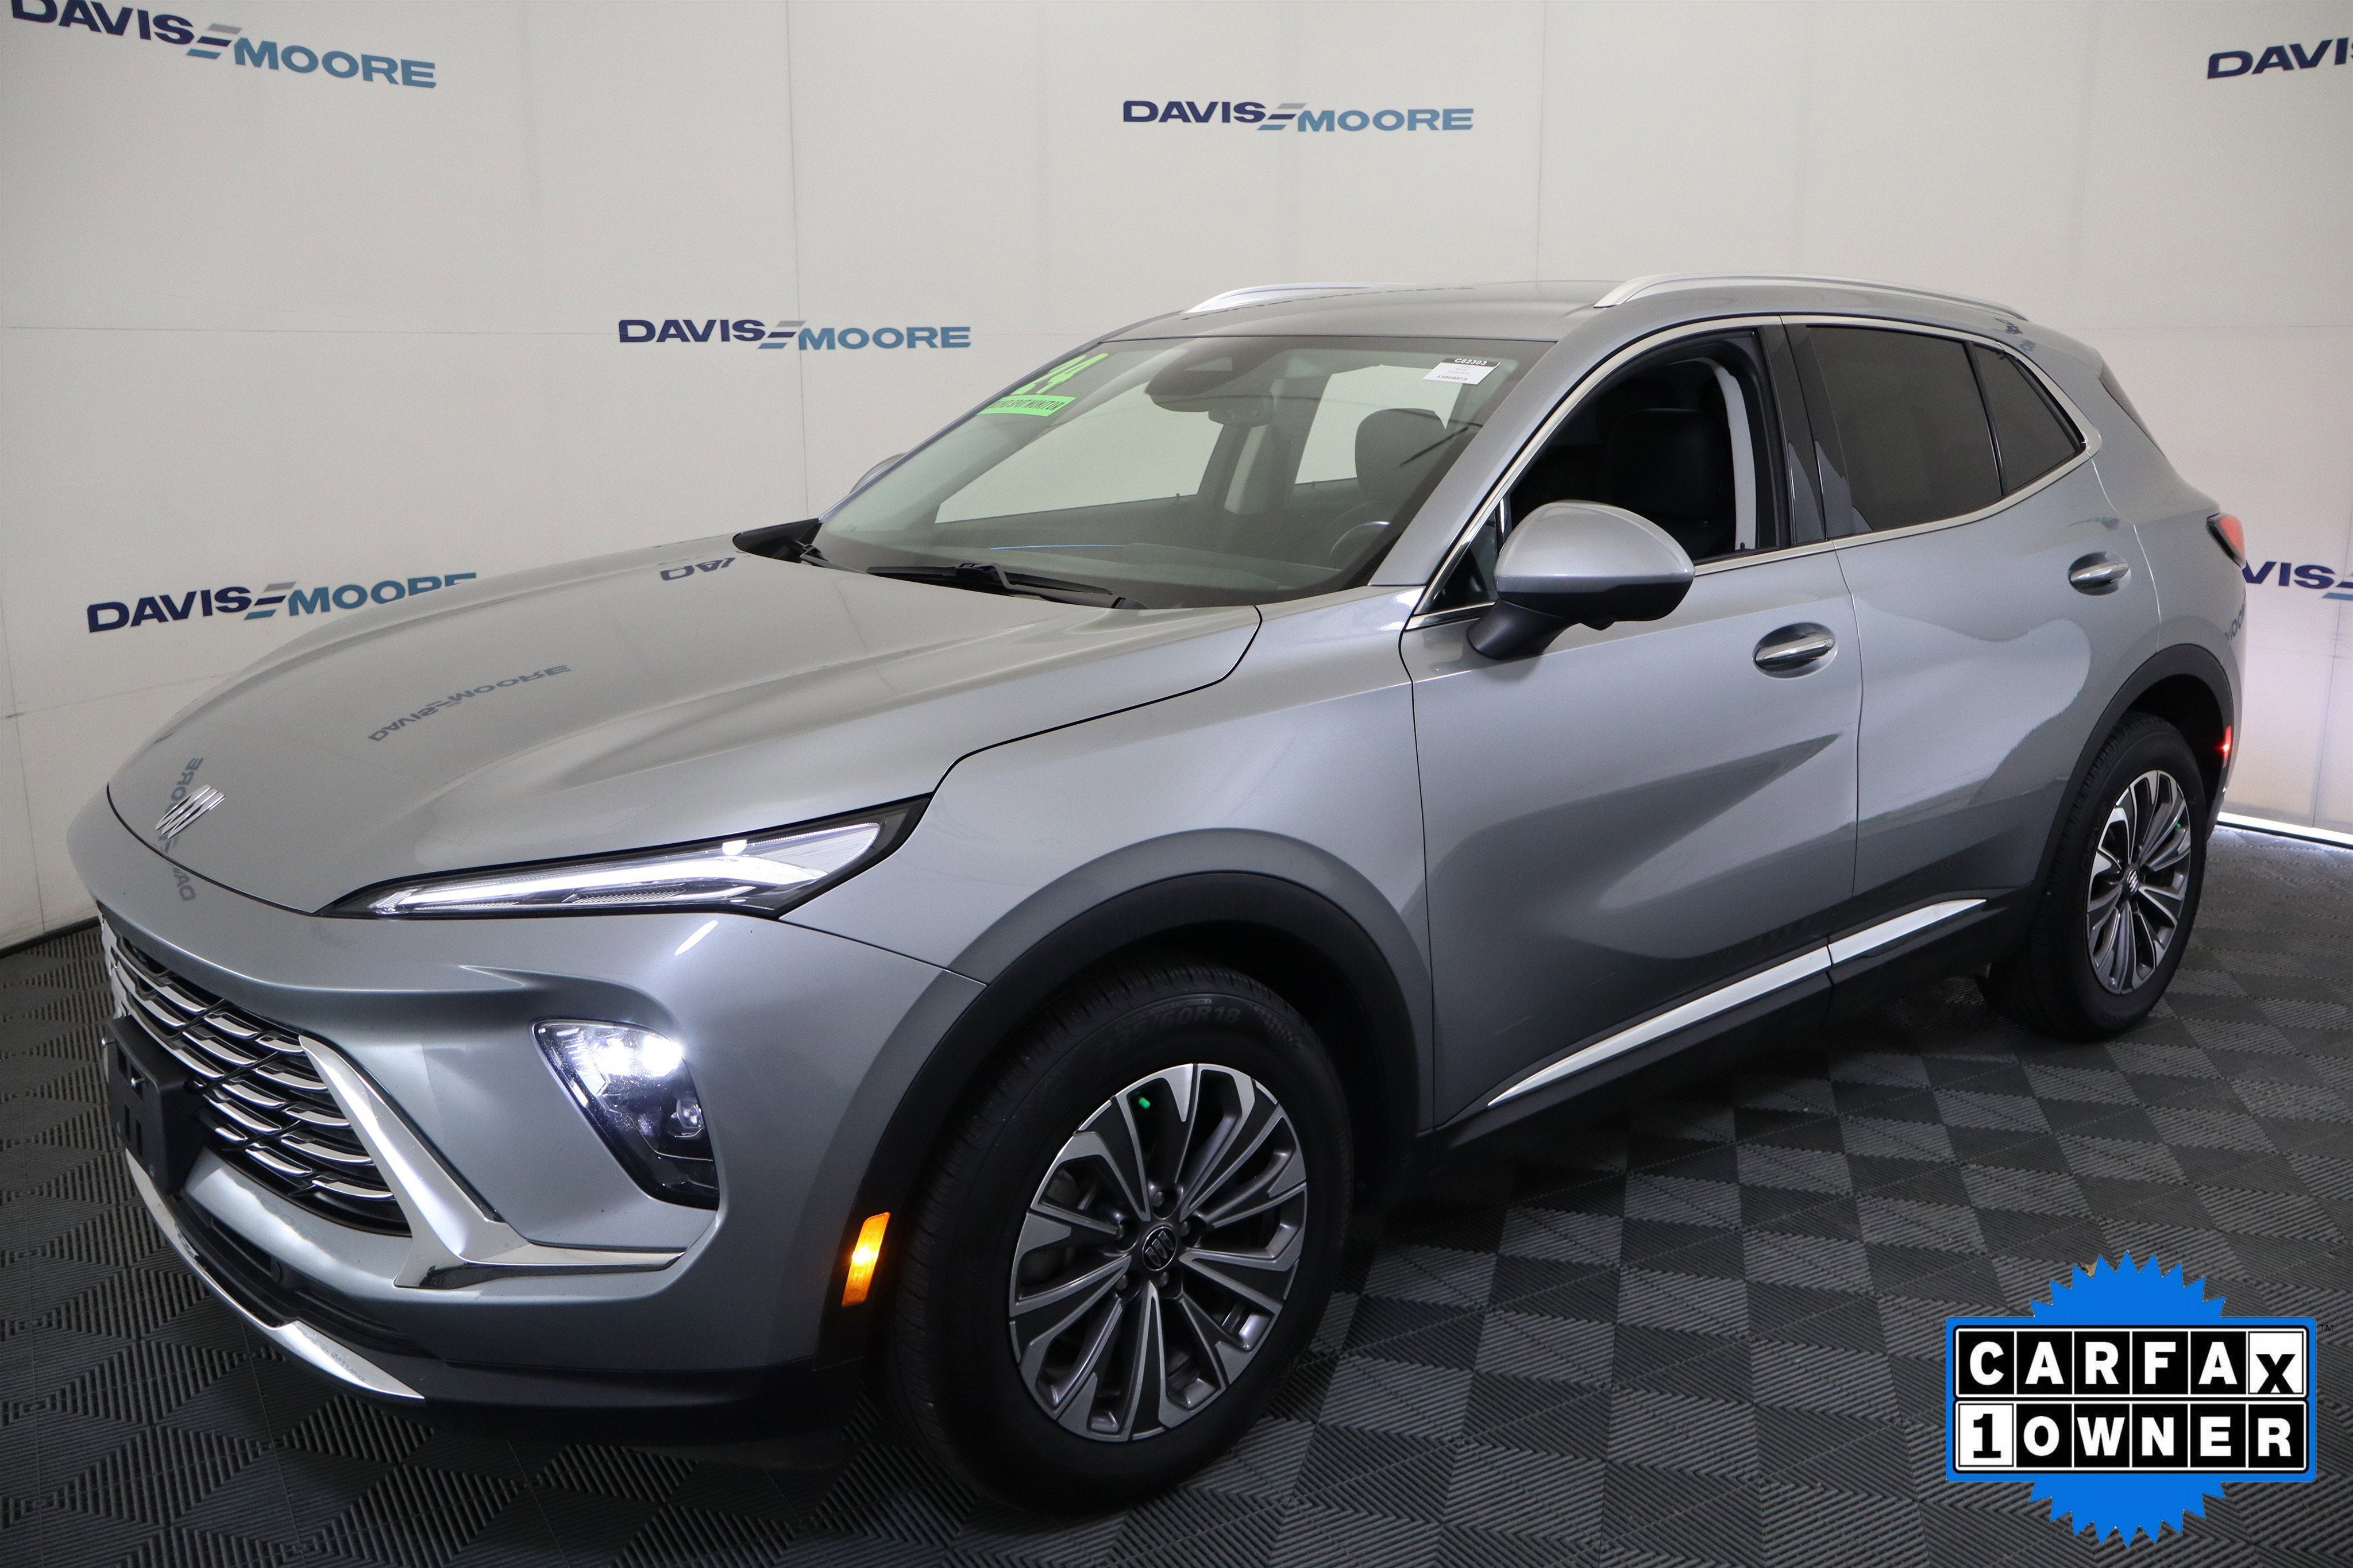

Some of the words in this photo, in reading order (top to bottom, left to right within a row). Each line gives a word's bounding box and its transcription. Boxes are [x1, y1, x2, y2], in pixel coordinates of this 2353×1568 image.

[11, 0, 194, 44] DAVIS
[234, 37, 436, 88] MOORE
[2207, 37, 2353, 79] DAVI
[1124, 101, 1266, 123] DAVIS
[1298, 109, 1473, 131] MOORE
[619, 320, 765, 342] DAVIS
[799, 327, 970, 350] MOORE
[2242, 561, 2335, 589] VIS
[87, 586, 252, 633] DAVIS
